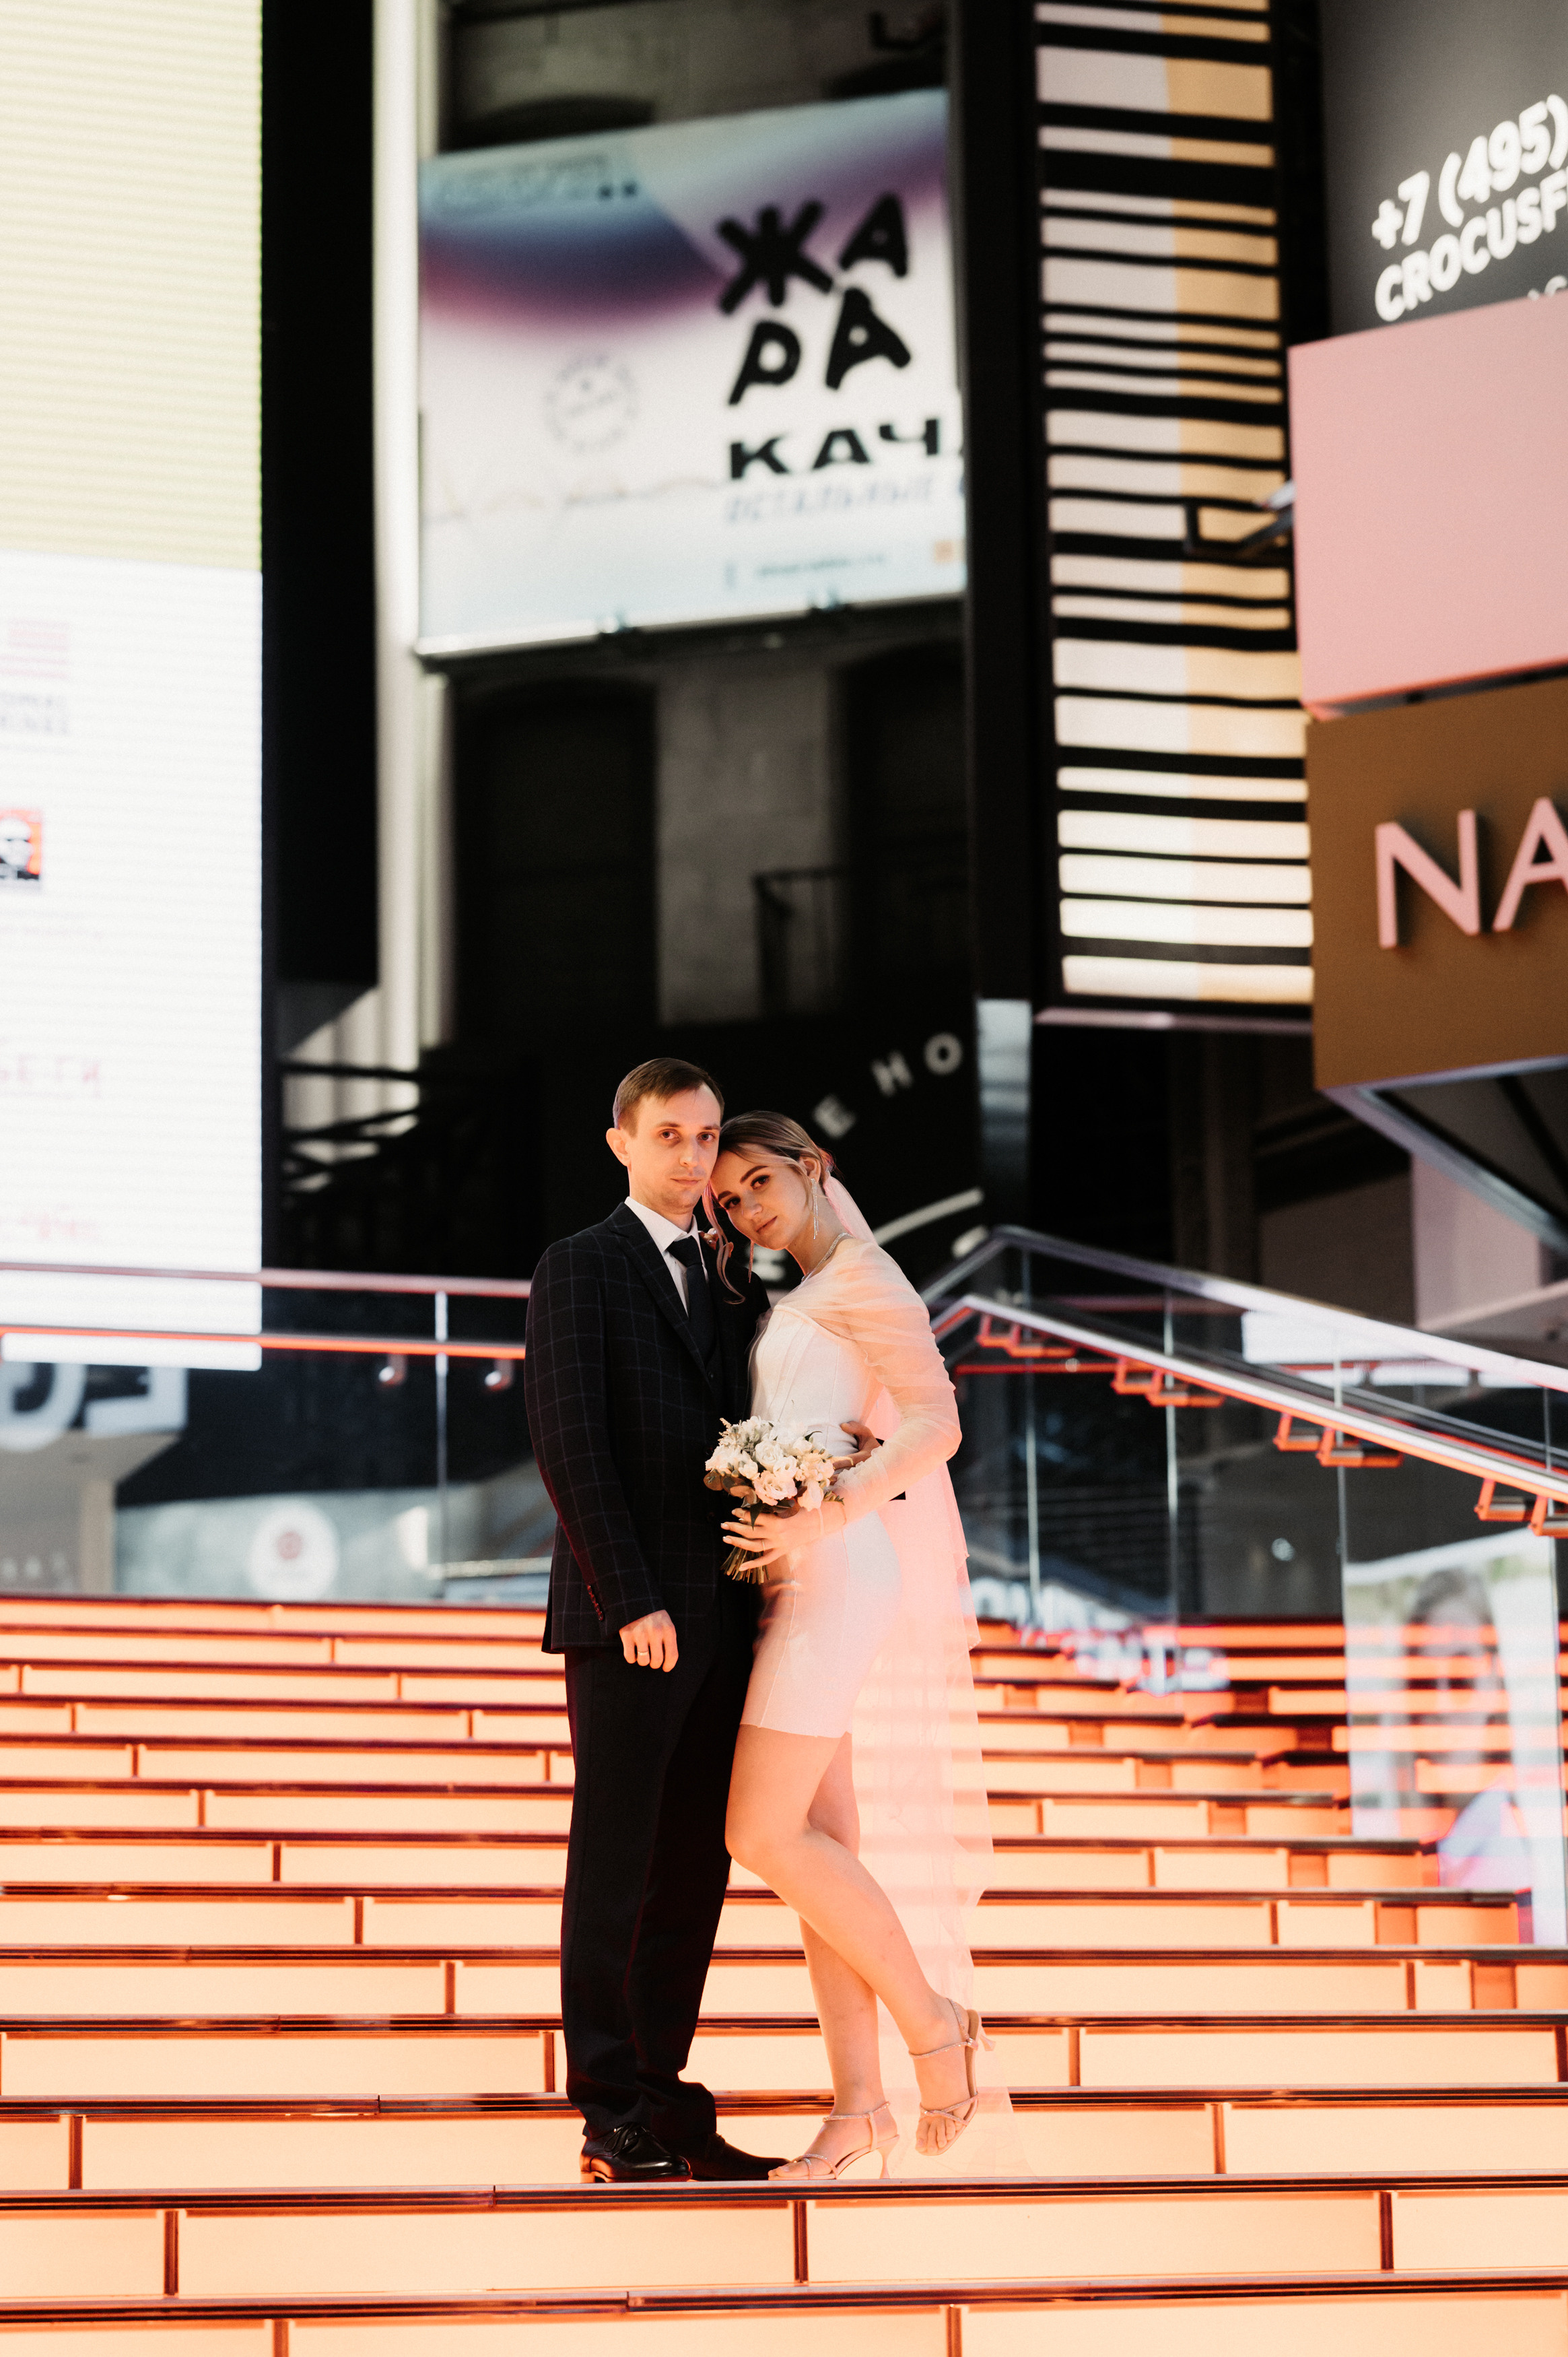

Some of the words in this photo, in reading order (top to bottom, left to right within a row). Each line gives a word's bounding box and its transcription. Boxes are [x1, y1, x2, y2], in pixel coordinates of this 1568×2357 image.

[1371, 170, 1430, 250] +7
[1438, 94, 1568, 228] (495)
[715, 191, 909, 314] ЖА
[1375, 168, 1568, 322] CROCUSF
[728, 286, 912, 405] РА
[729, 417, 963, 480] КАЧ
